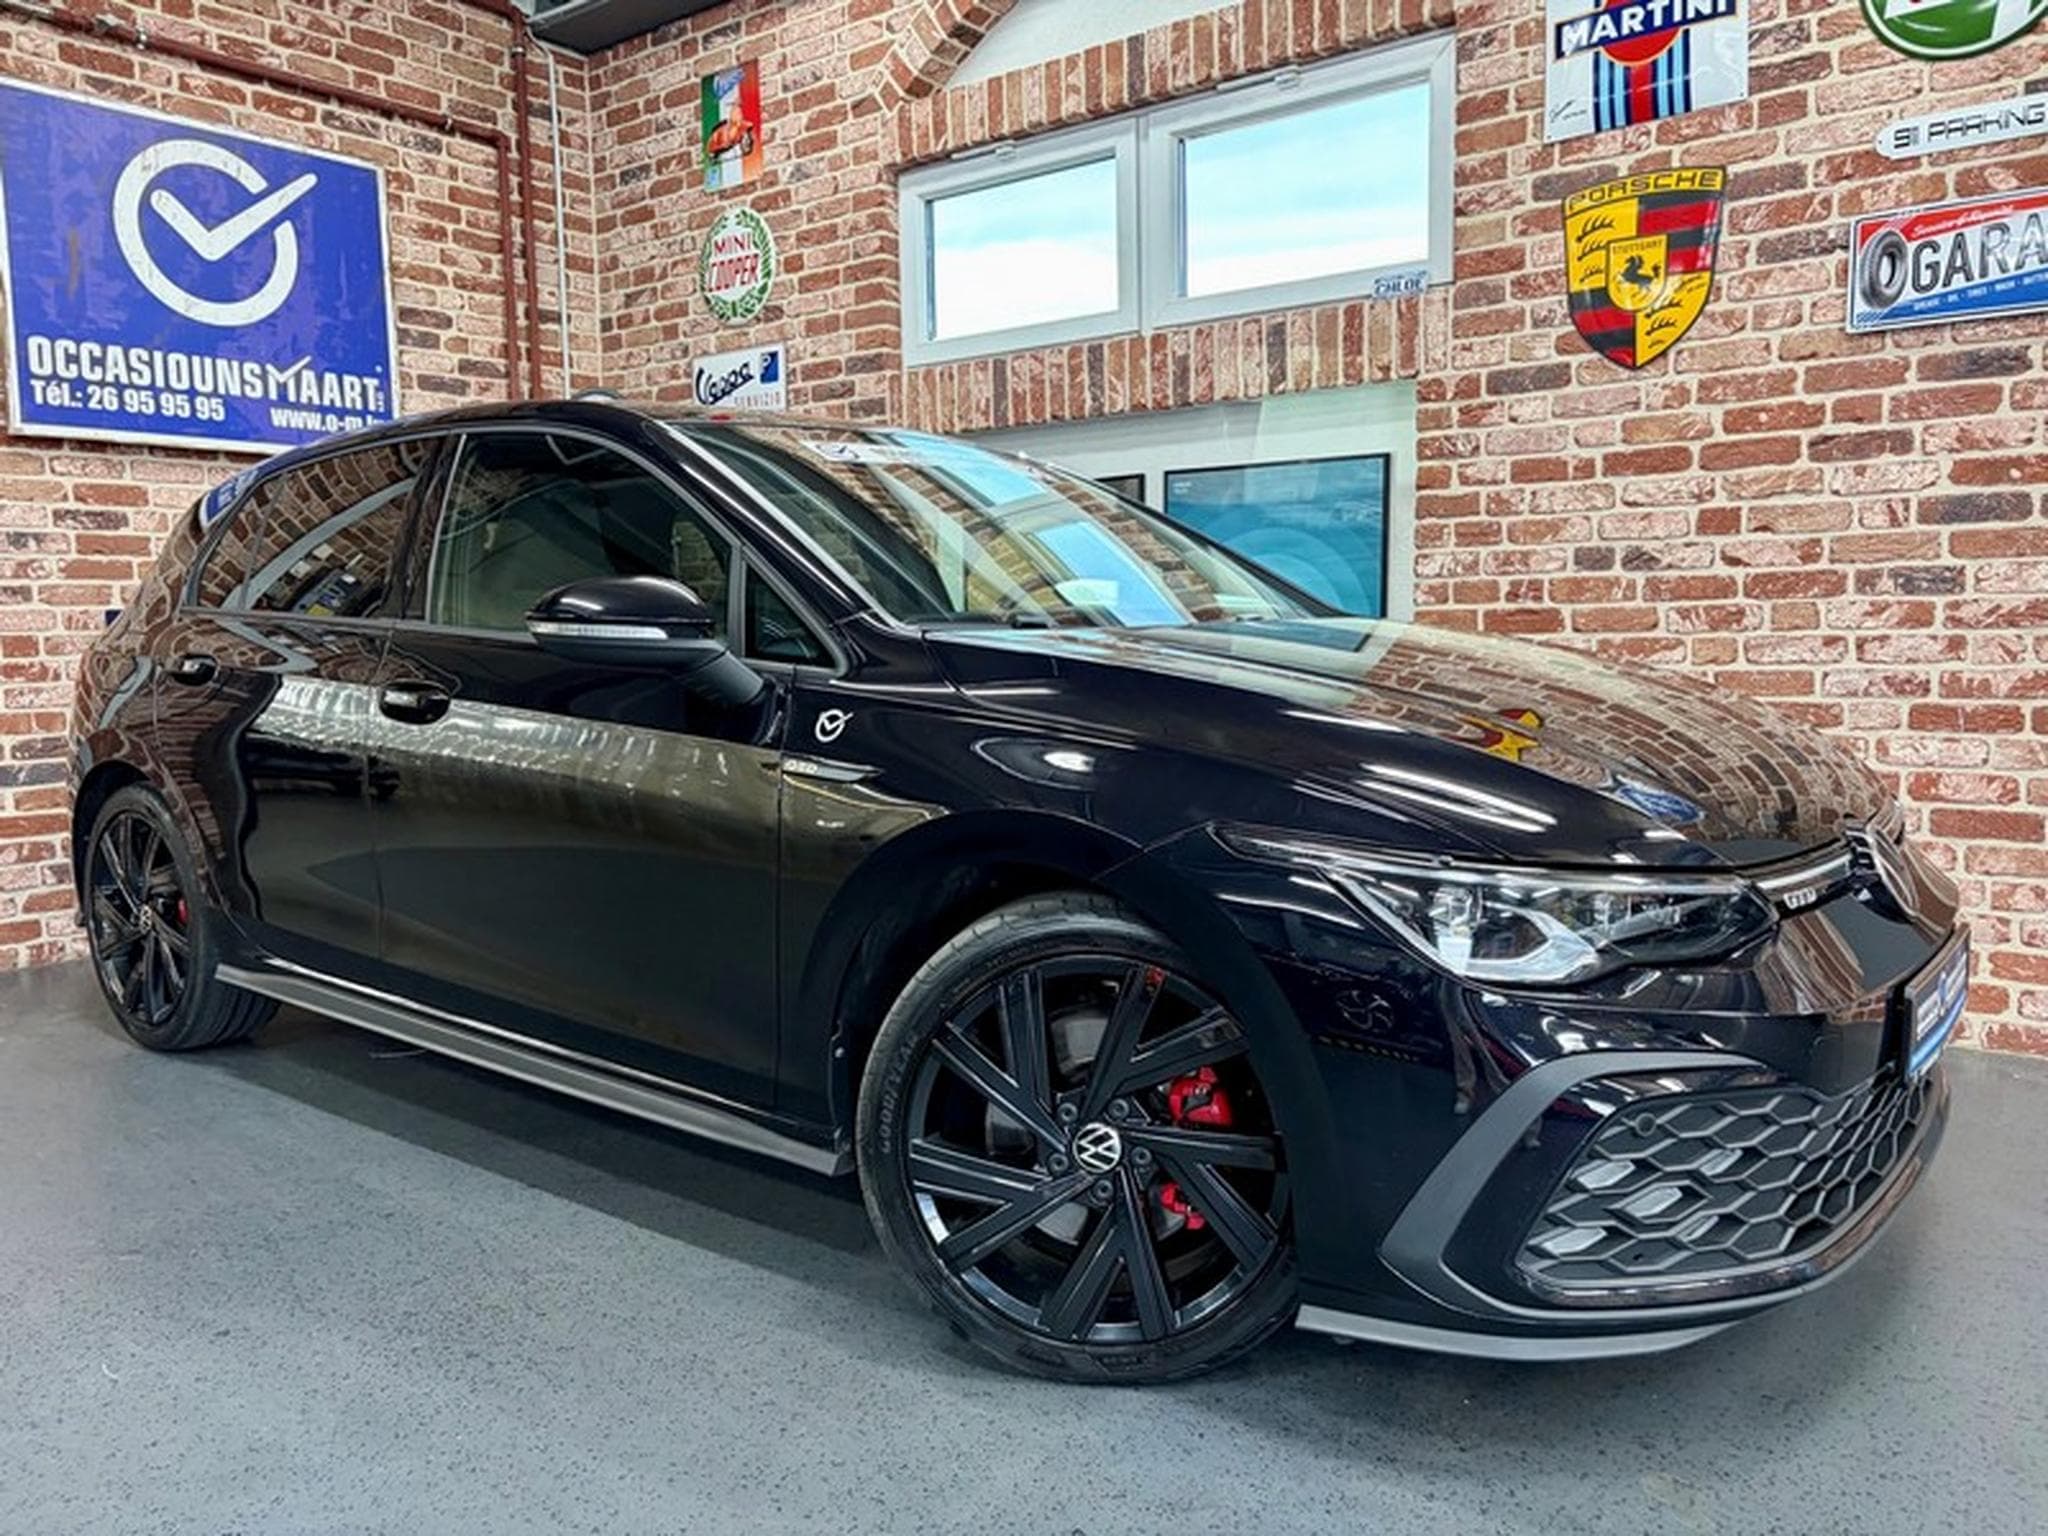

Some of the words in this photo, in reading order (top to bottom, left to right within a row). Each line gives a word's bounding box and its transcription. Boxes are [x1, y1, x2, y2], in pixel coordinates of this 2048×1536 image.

[1927, 102, 2046, 142] PARKING
[1569, 171, 1720, 212] PORSCHE
[714, 232, 751, 258] MINI
[708, 253, 760, 293] COOPER
[86, 384, 120, 412] 26
[123, 387, 156, 415] 95
[159, 392, 192, 420] 95
[195, 396, 226, 421] 95
